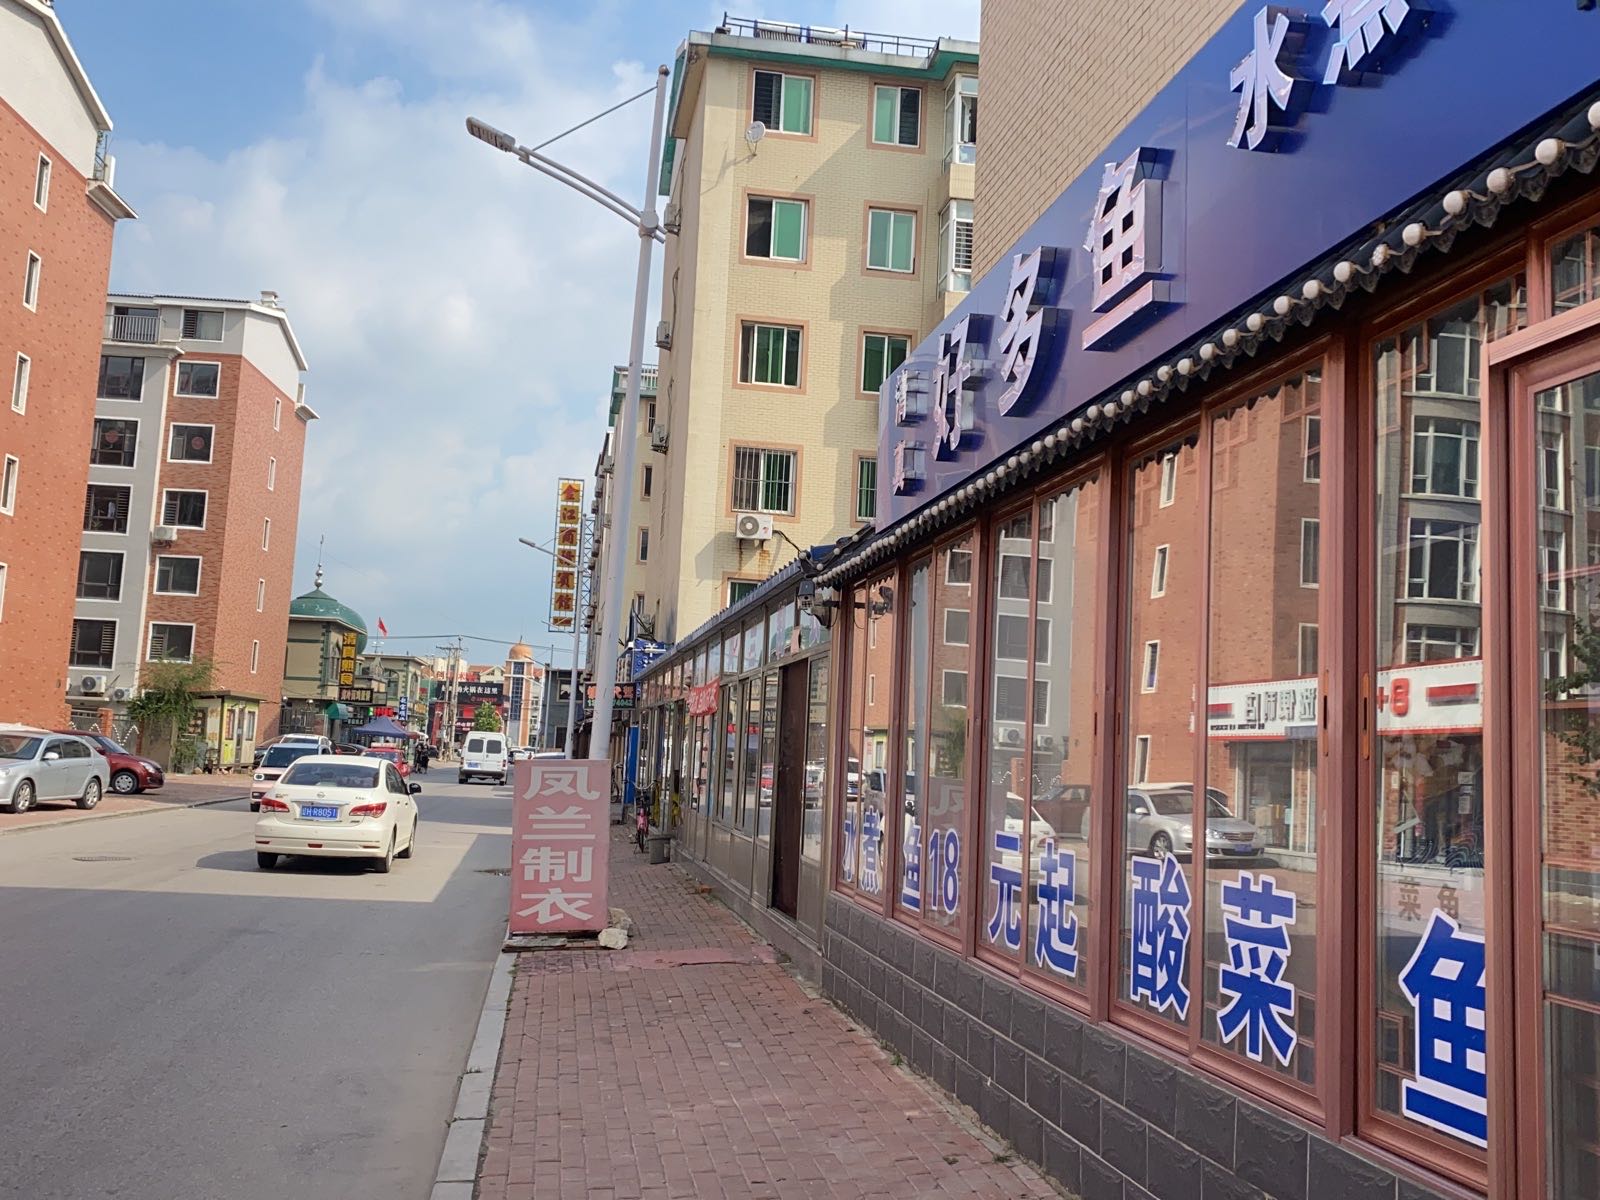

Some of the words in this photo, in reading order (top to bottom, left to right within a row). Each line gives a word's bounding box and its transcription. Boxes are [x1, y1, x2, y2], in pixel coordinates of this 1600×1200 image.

[931, 147, 1162, 461] 好多鱼
[516, 766, 601, 925] 凤兰制衣
[1130, 852, 1488, 1148] 酸菜鱼
